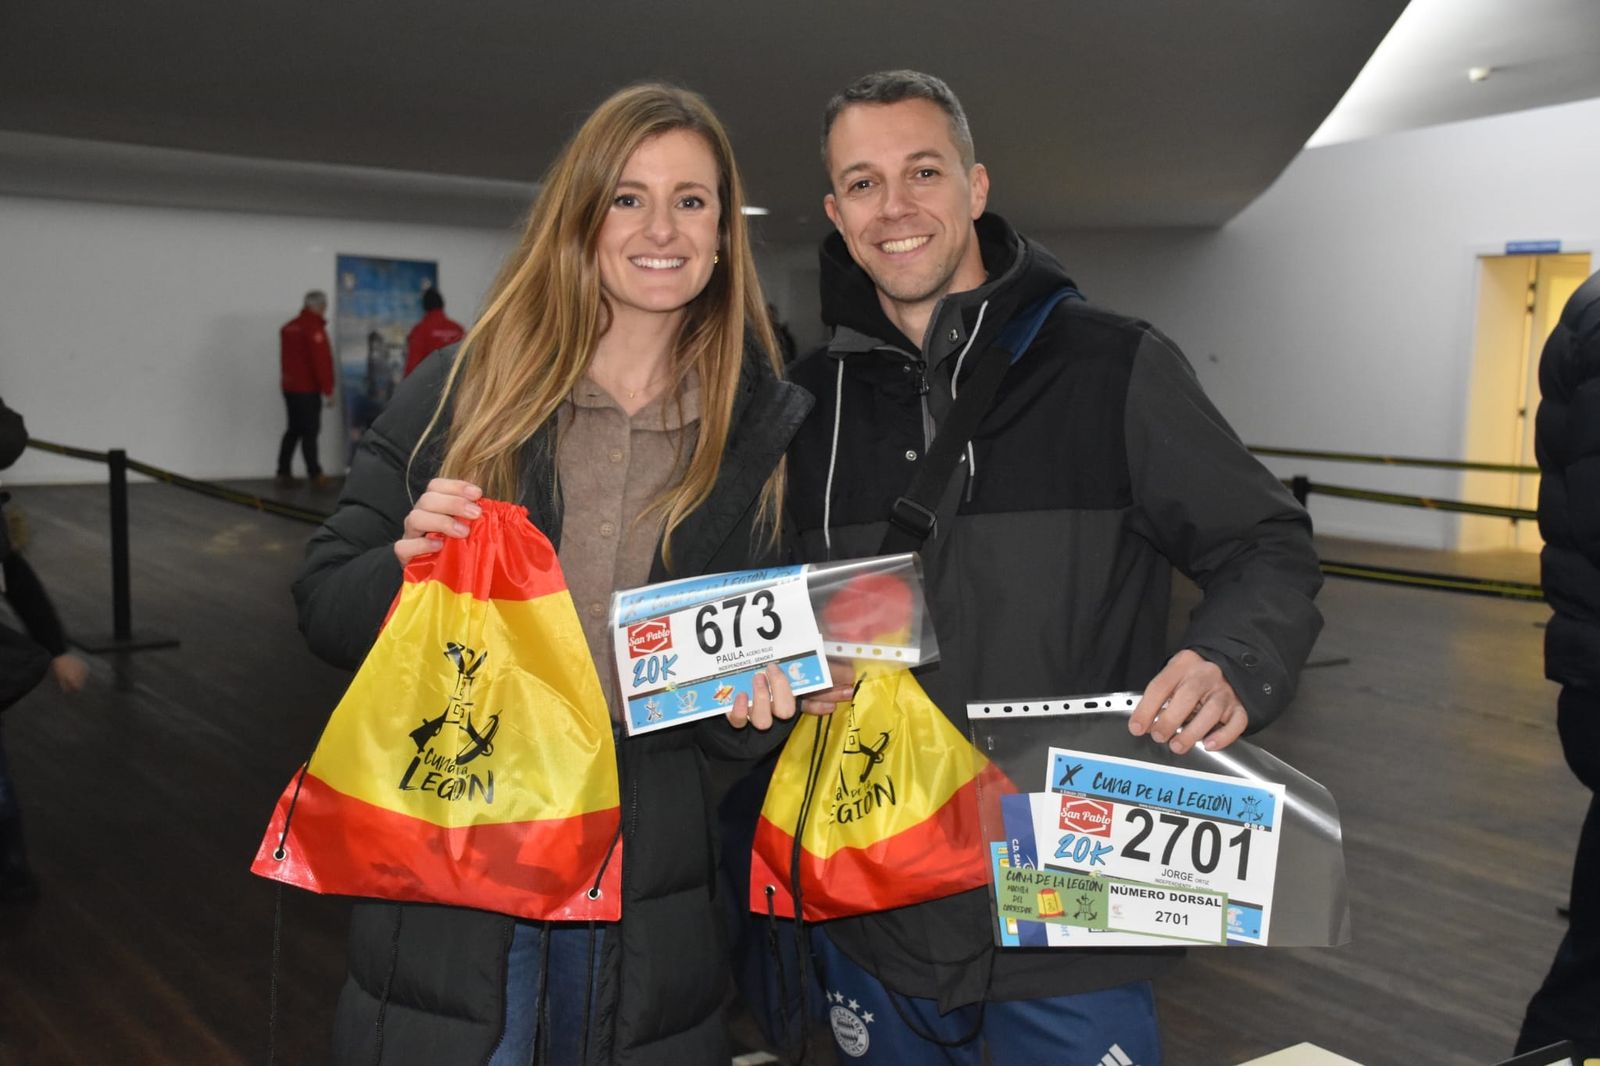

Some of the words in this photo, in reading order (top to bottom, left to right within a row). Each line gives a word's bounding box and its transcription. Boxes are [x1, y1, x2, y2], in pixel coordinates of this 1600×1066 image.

[695, 589, 782, 655] 673
[630, 635, 645, 647] San
[645, 628, 671, 642] Pablo
[716, 650, 745, 664] PAULA
[632, 654, 678, 688] 20K
[1059, 763, 1084, 786] X
[1060, 807, 1080, 820] San
[1081, 810, 1111, 825] Pablo
[1054, 833, 1114, 866] 20K
[1119, 807, 1252, 882] 2701
[1006, 870, 1032, 884] CUNA
[1034, 873, 1051, 885] DE
[1053, 876, 1065, 888] LA
[1161, 868, 1194, 882] JORGE
[1195, 878, 1210, 886] ORTIZ
[1110, 885, 1165, 900] NÚMERO
[1169, 893, 1222, 907] DORSAL
[1155, 910, 1189, 926] 2701
